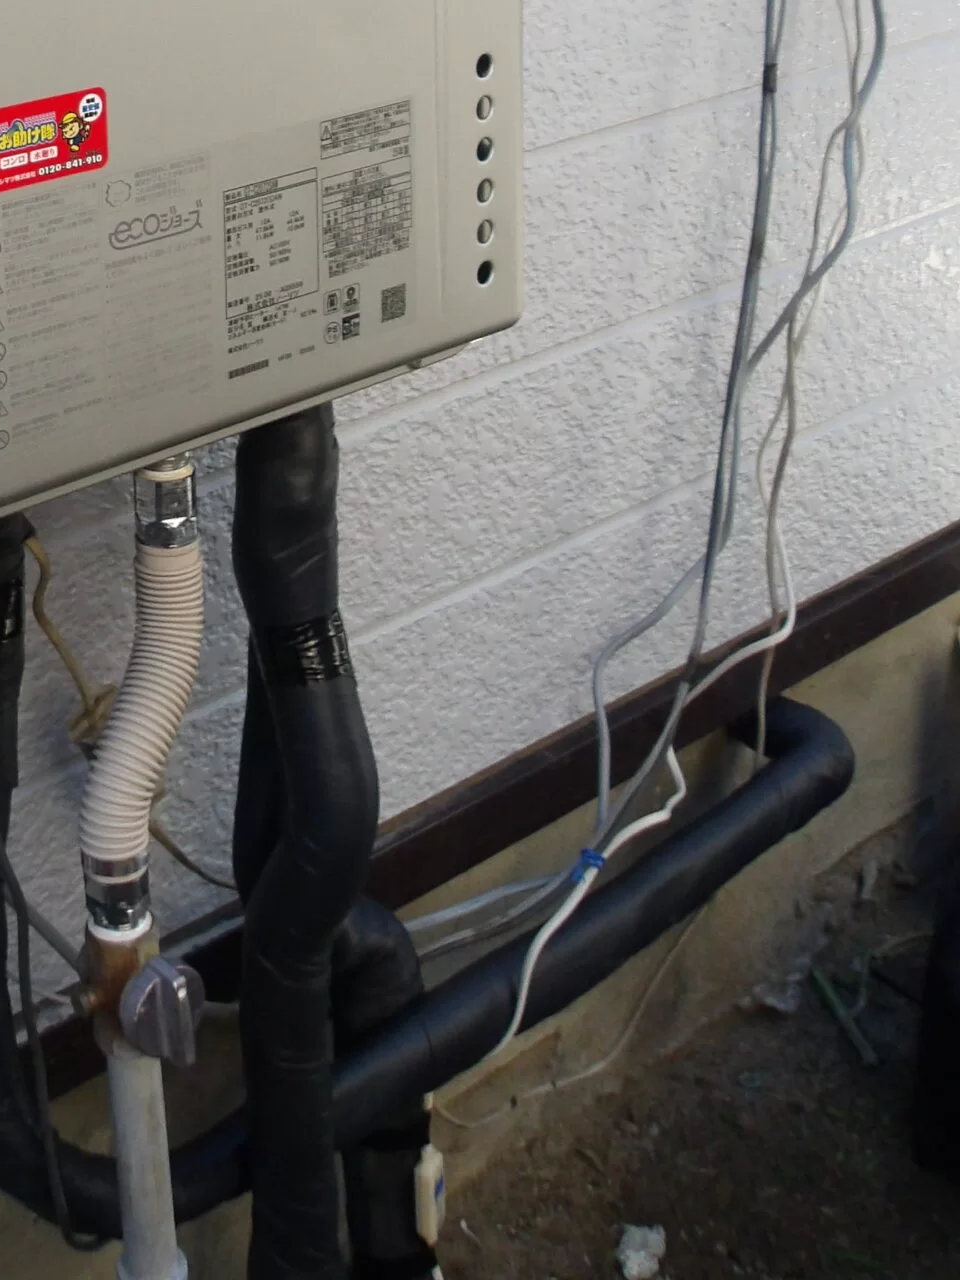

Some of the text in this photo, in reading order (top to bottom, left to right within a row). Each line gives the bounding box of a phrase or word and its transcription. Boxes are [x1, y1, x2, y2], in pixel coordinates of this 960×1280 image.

[2, 156, 27, 167] コンロ
[38, 154, 103, 176] 0120-841-910
